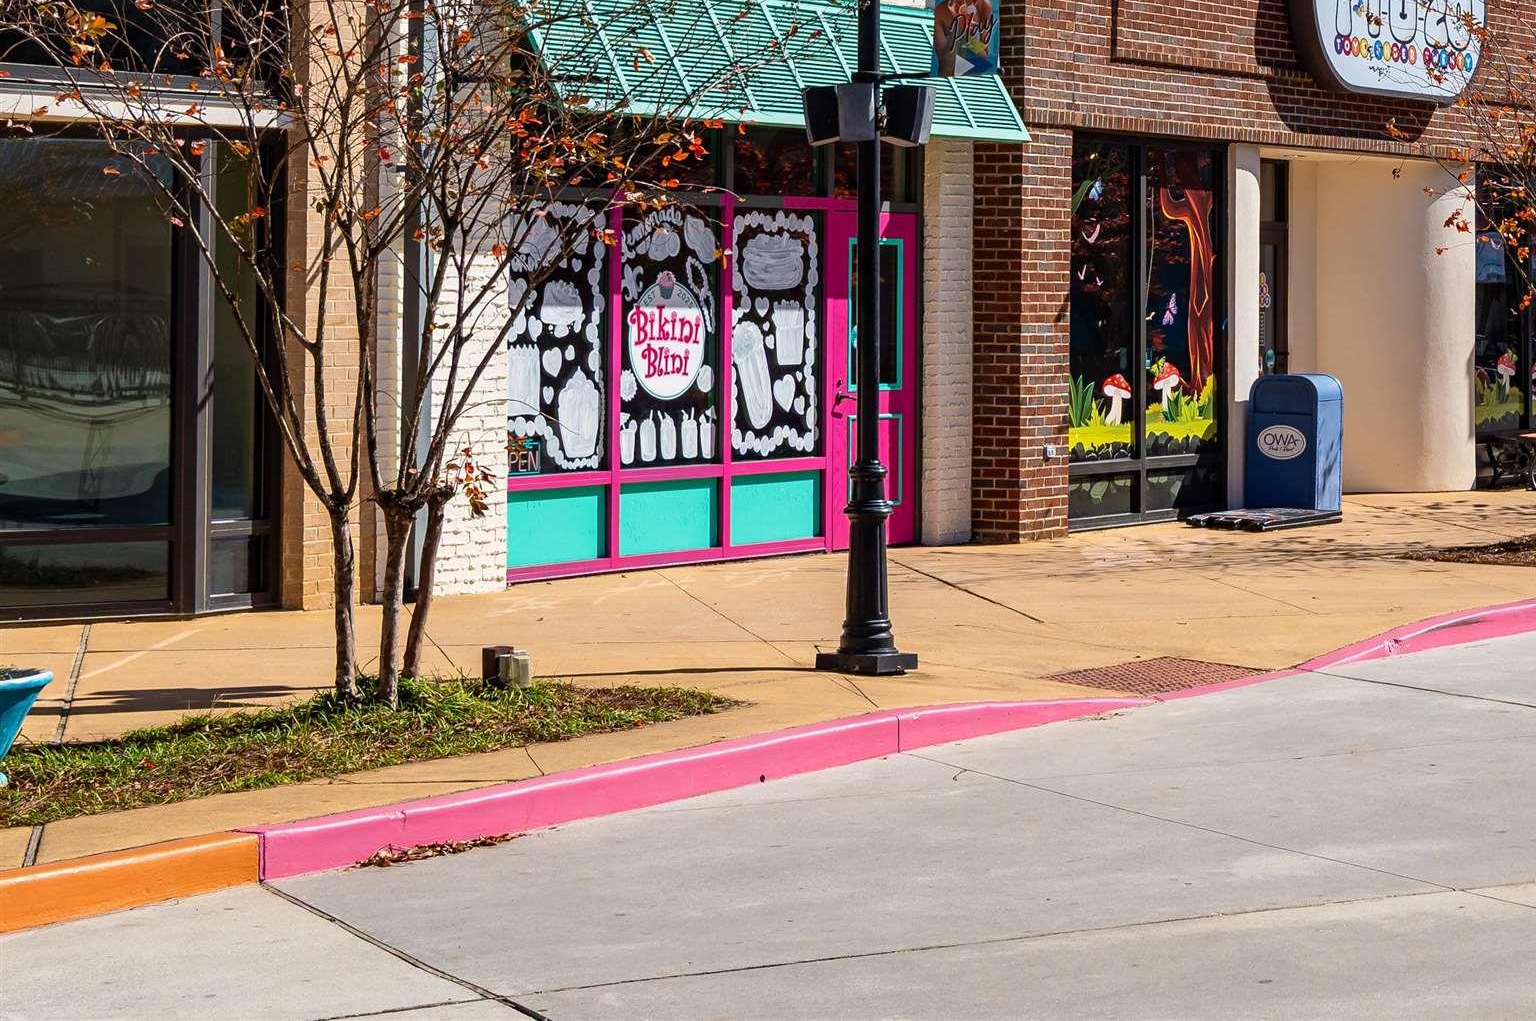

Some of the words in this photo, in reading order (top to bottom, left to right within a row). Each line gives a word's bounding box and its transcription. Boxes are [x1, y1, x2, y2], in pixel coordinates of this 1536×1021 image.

[950, 12, 998, 53] Play
[643, 290, 656, 306] EST
[629, 304, 701, 346] Bikini
[641, 343, 690, 378] Blini
[1264, 433, 1298, 446] OWA
[509, 450, 539, 472] PEN
